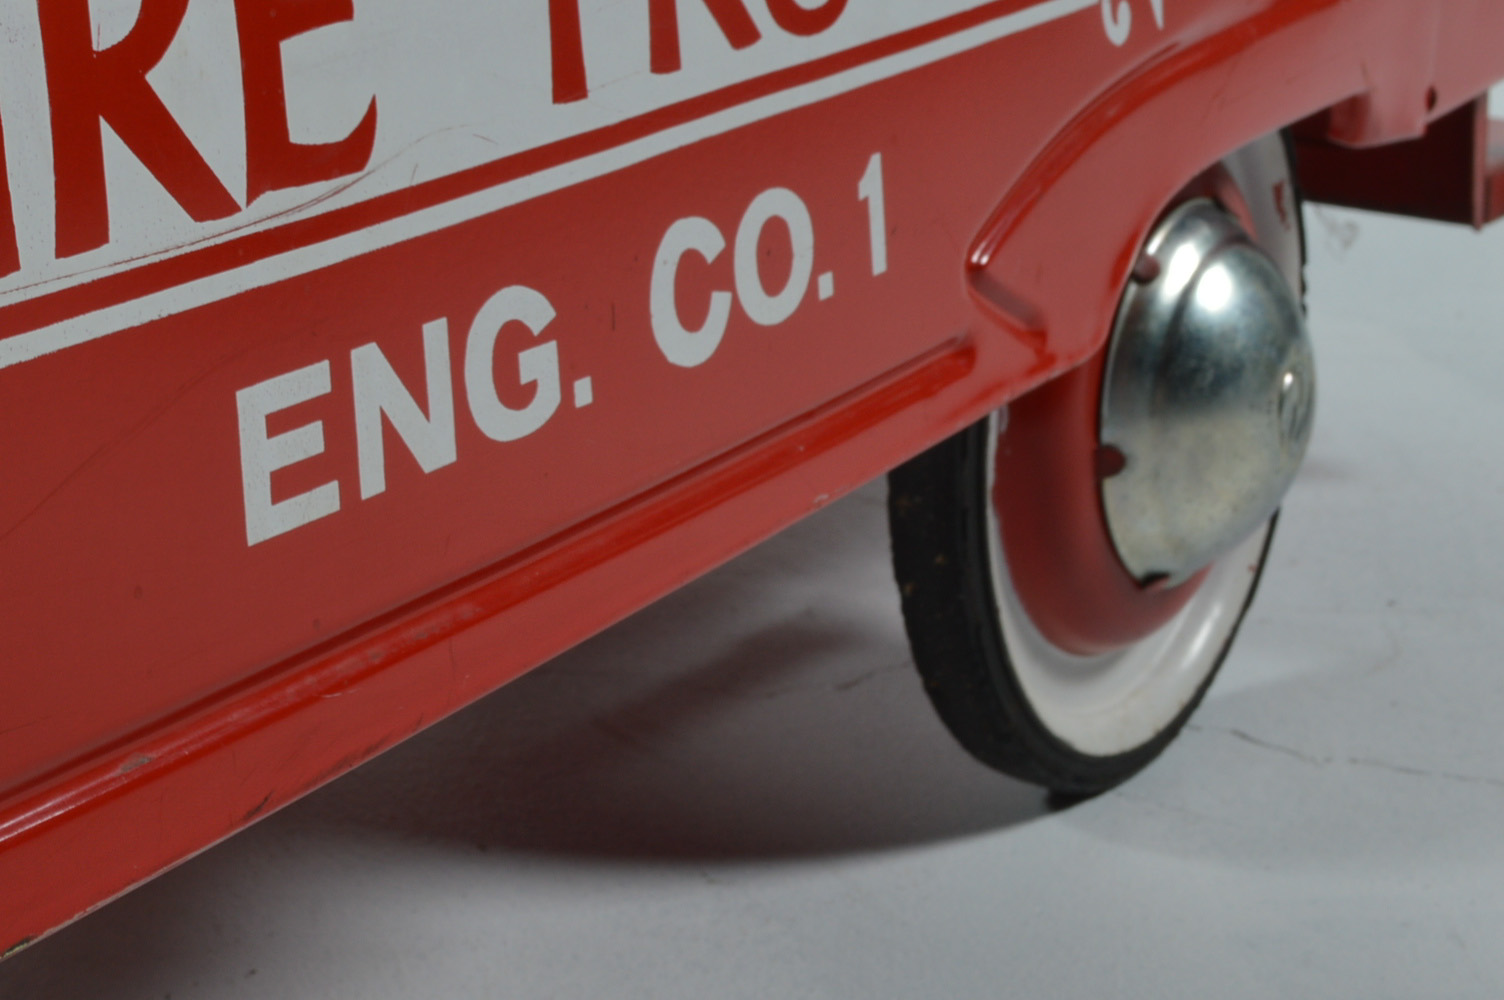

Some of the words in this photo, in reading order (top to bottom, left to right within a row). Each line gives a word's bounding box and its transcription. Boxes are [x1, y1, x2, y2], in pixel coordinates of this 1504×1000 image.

[236, 285, 593, 547] ENG.
[649, 187, 834, 368] CO.
[858, 152, 887, 276] 1
